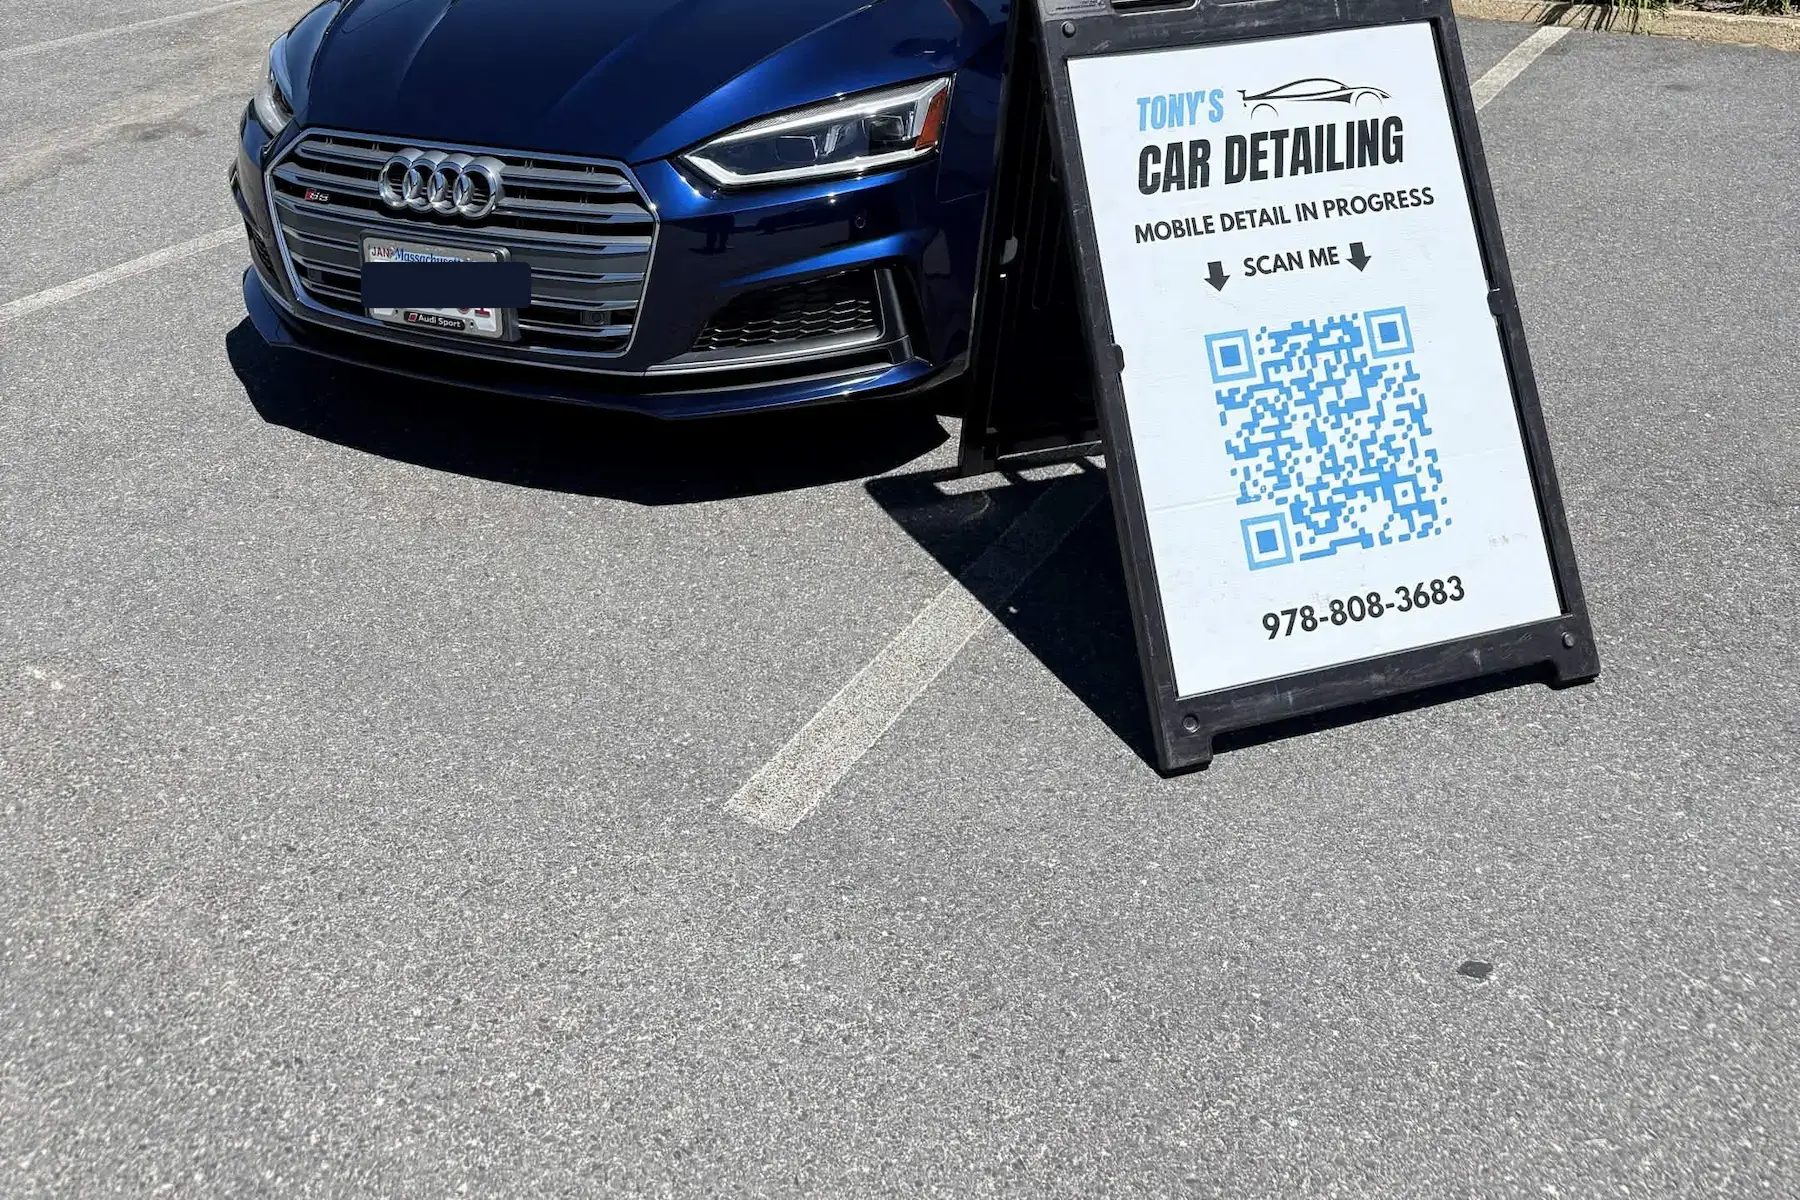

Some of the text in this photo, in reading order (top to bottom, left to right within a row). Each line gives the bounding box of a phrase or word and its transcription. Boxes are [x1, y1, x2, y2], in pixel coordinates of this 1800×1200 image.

[1137, 88, 1224, 131] TONY'S
[1138, 115, 1404, 196] CAR DETAILING
[1134, 186, 1435, 244] MOBILE DETAIL IN PROGRESS
[371, 247, 389, 258] JAN
[395, 248, 463, 262] Massachus
[1243, 246, 1340, 276] SCAN ME
[418, 315, 461, 328] Audi Sport
[1262, 575, 1465, 640] 978-808-3683
